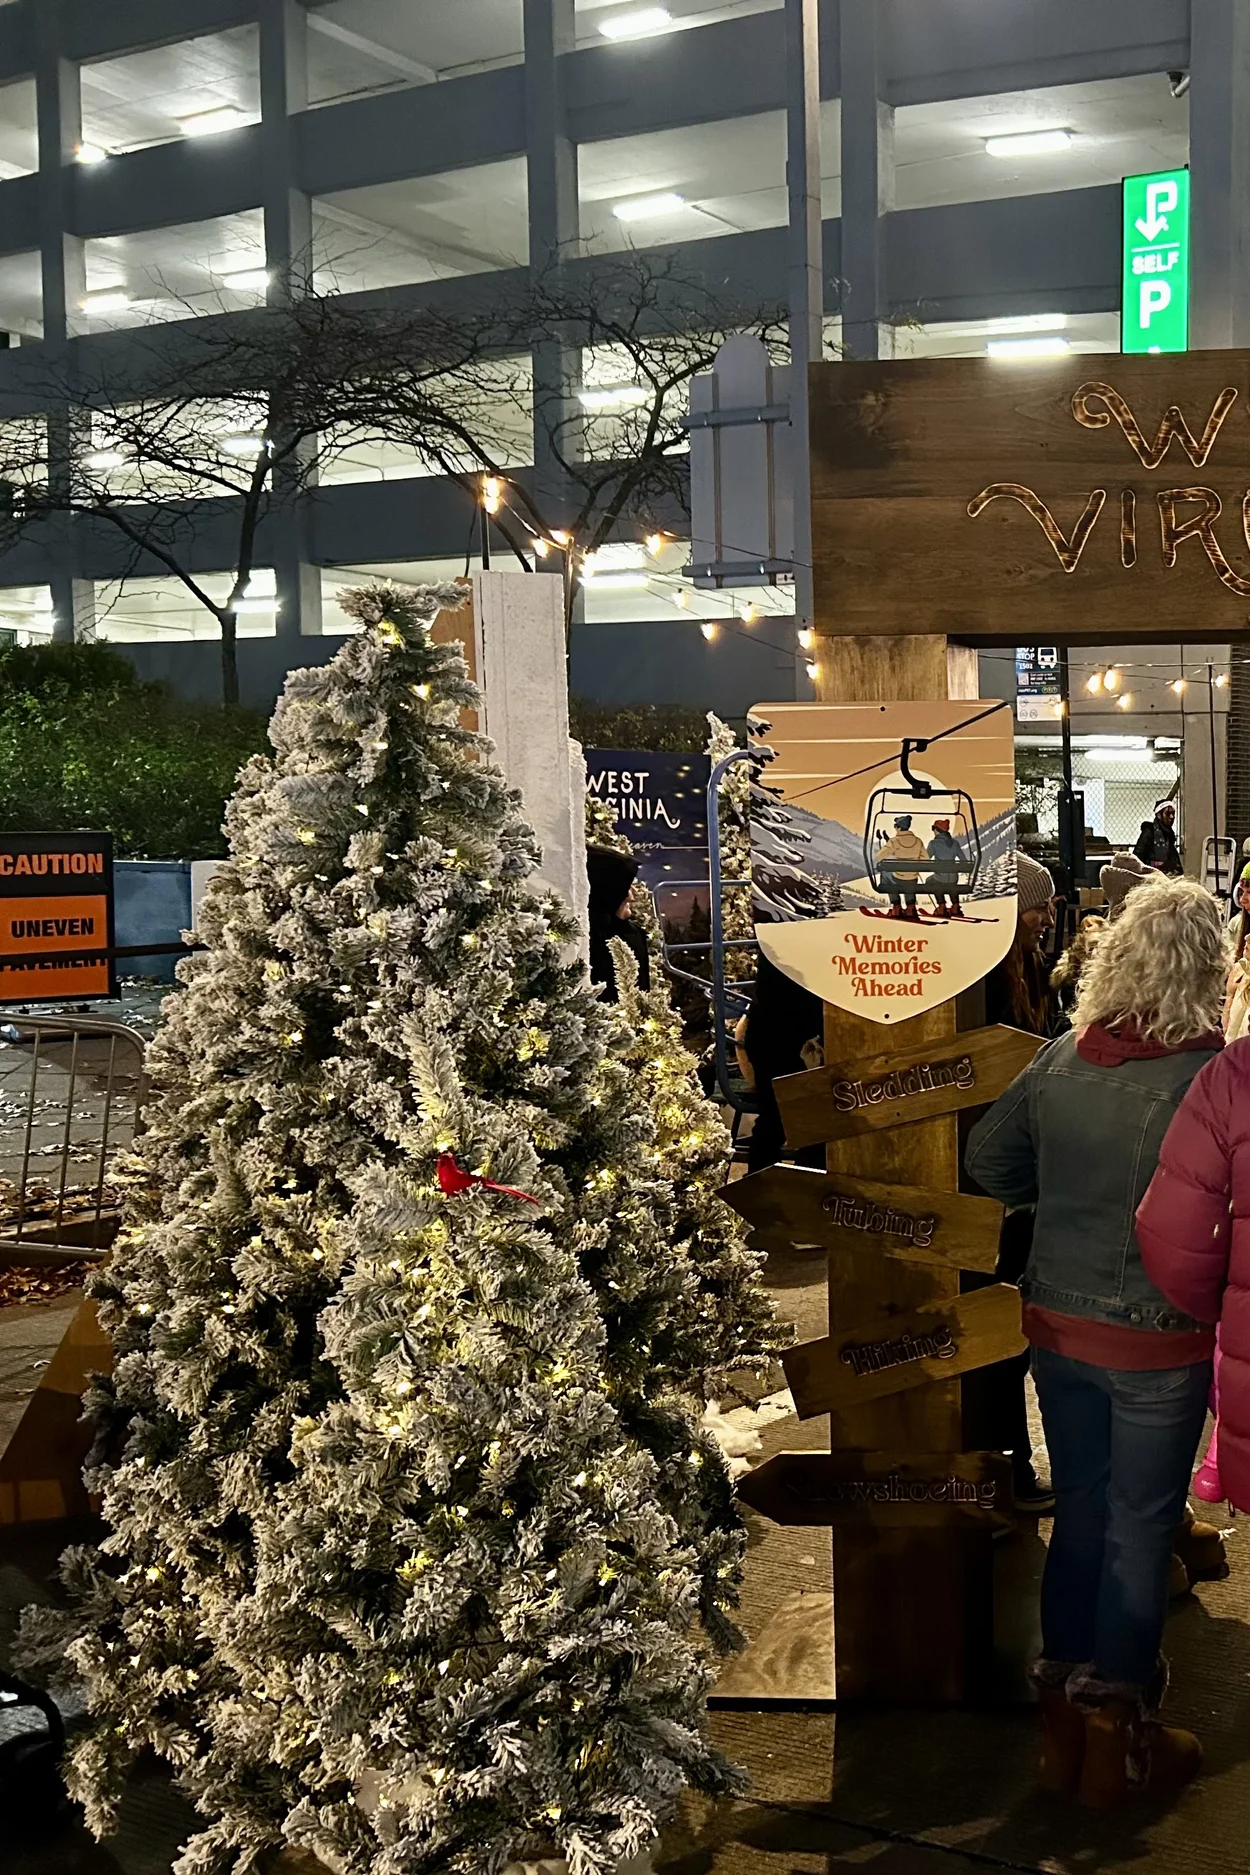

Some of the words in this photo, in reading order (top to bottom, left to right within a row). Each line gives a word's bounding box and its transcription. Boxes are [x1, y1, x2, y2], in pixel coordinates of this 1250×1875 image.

[1132, 252, 1179, 275] SELF
[586, 770, 650, 794] WEST
[0, 853, 104, 876] CAUTION
[11, 918, 94, 939] UNEVEN
[844, 933, 928, 953] Winter
[832, 955, 942, 975] Memories
[851, 977, 923, 997] Ahead
[832, 1056, 976, 1114] Sledding
[822, 1196, 935, 1247] Tubing
[840, 1324, 958, 1377] Hiking
[783, 1475, 996, 1510] owshoeing
